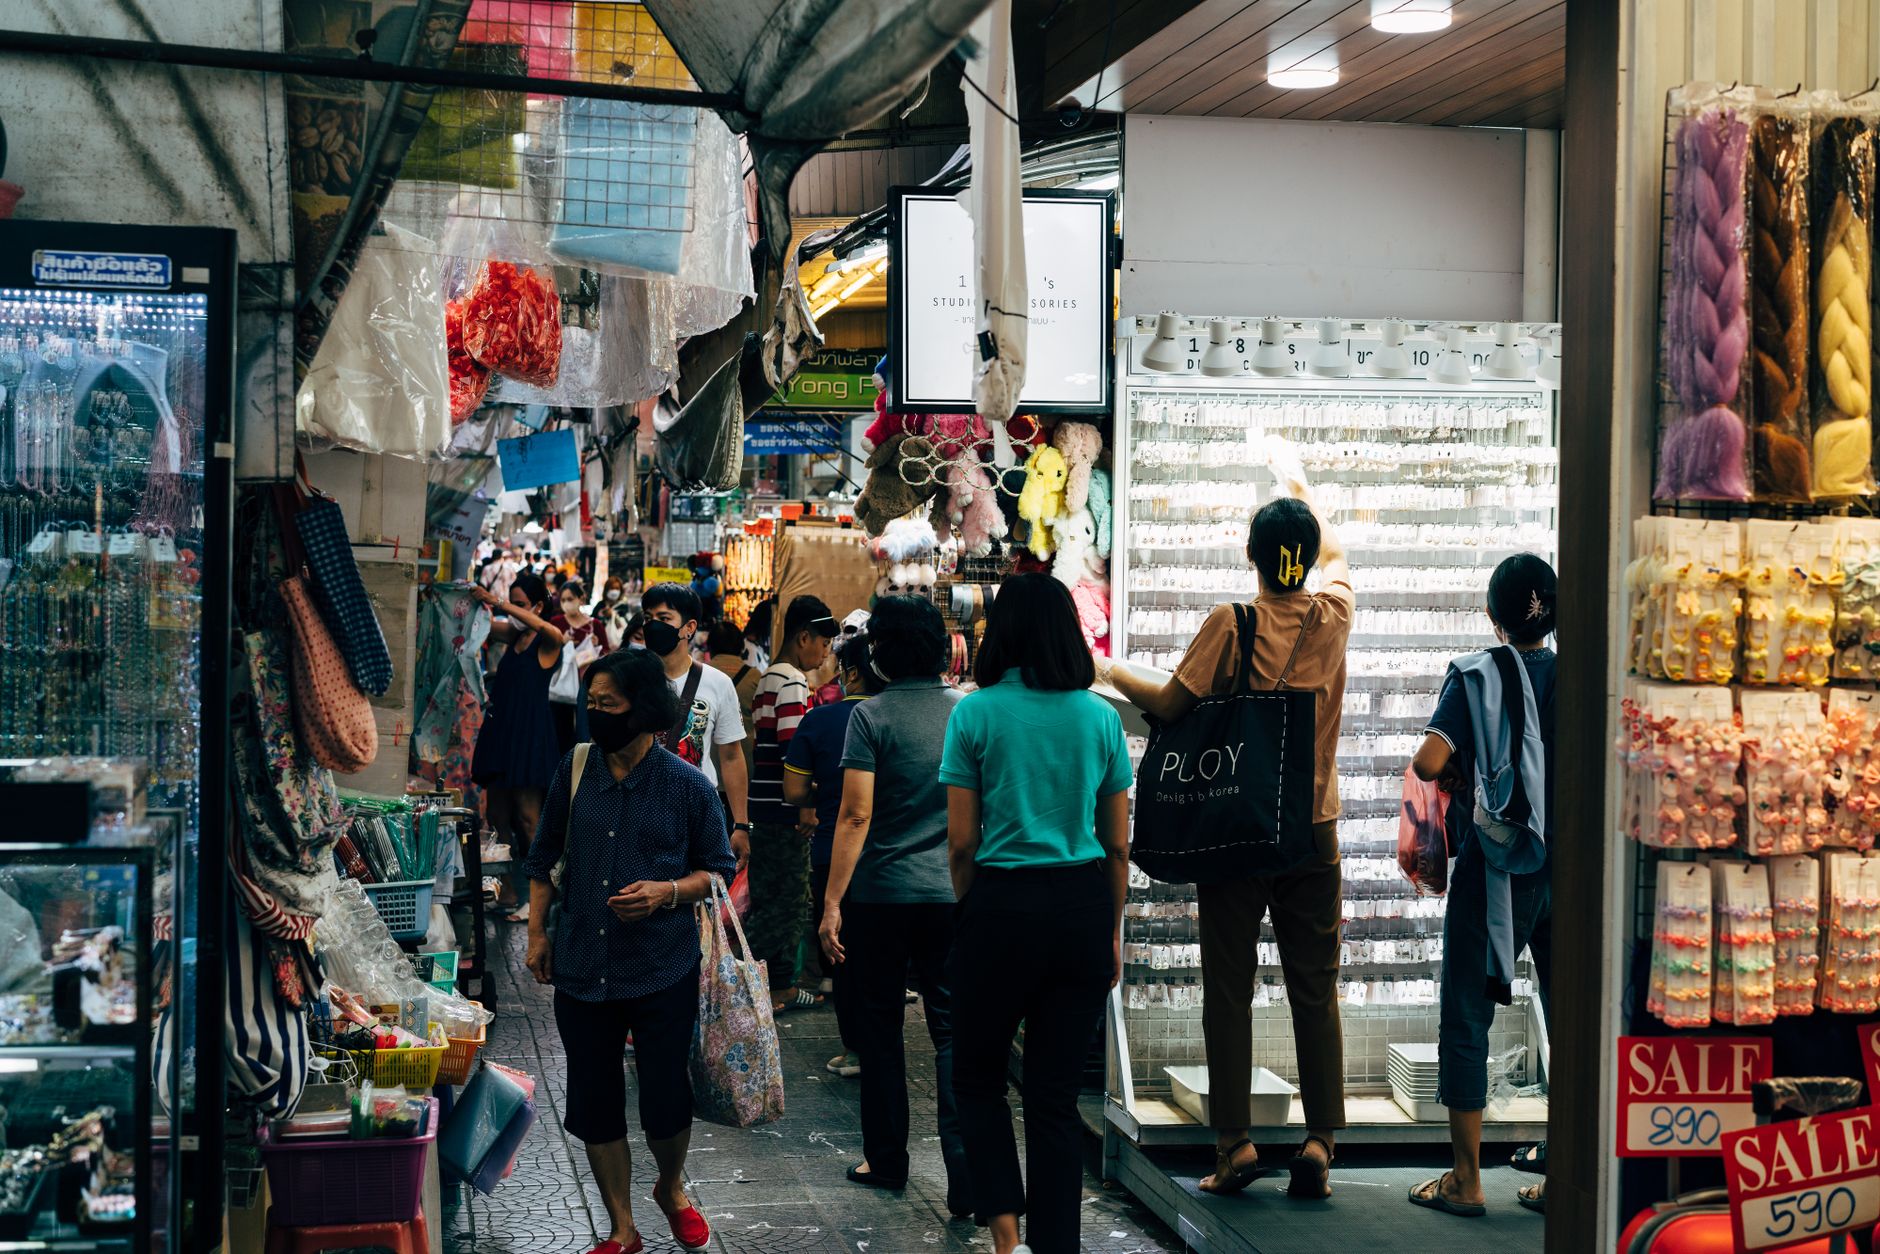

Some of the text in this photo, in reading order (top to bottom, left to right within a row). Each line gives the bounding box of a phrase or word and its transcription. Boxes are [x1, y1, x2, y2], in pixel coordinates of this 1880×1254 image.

[933, 297, 1078, 309] STUDI SORIES
[788, 375, 848, 399] Yong
[1159, 742, 1245, 783] PLOY
[1628, 1042, 1761, 1096] SALE
[1648, 1105, 1722, 1146] 890
[1733, 1114, 1879, 1193] SALE
[1765, 1186, 1856, 1238] 590
